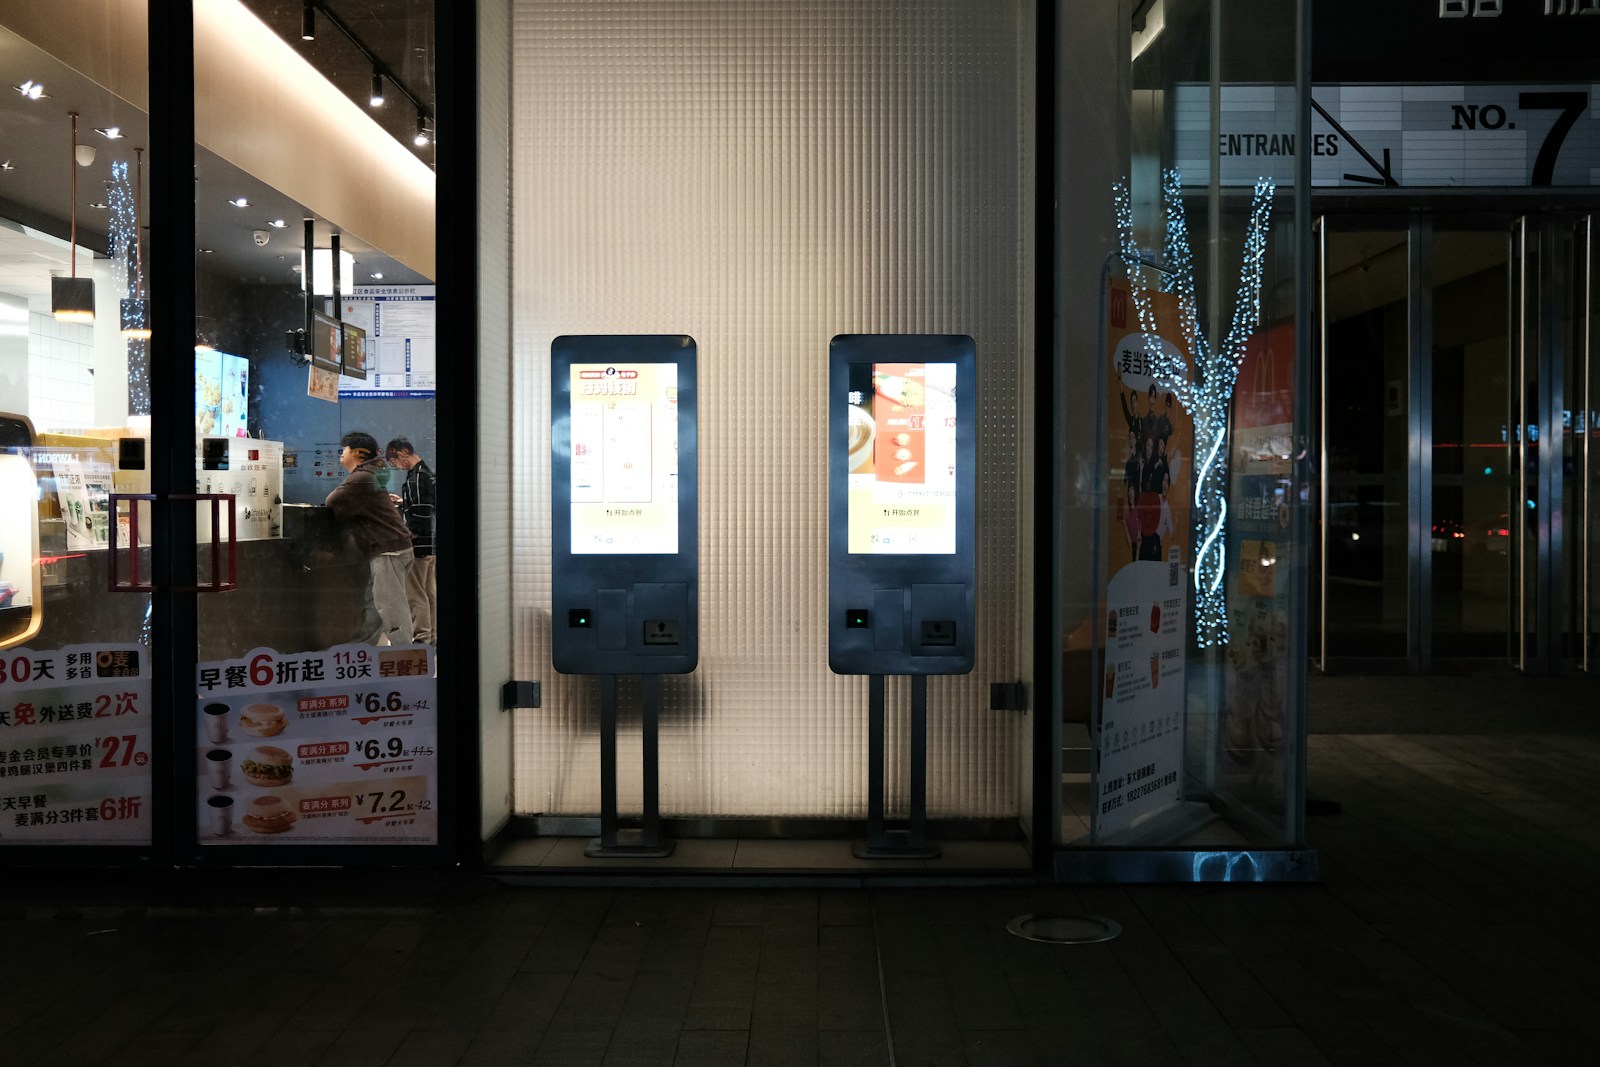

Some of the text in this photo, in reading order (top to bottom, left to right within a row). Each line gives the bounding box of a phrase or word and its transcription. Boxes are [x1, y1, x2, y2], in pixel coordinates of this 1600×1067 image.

[1220, 134, 1338, 156] ENTRANES
[1452, 92, 1588, 186] NO. 7
[66, 652, 92, 667] 多用
[379, 658, 428, 677] 早餐卡
[66, 667, 92, 681] 多省
[199, 654, 325, 691] 早餐6折起
[336, 664, 372, 680] 30天
[0, 795, 47, 811] 天早餐
